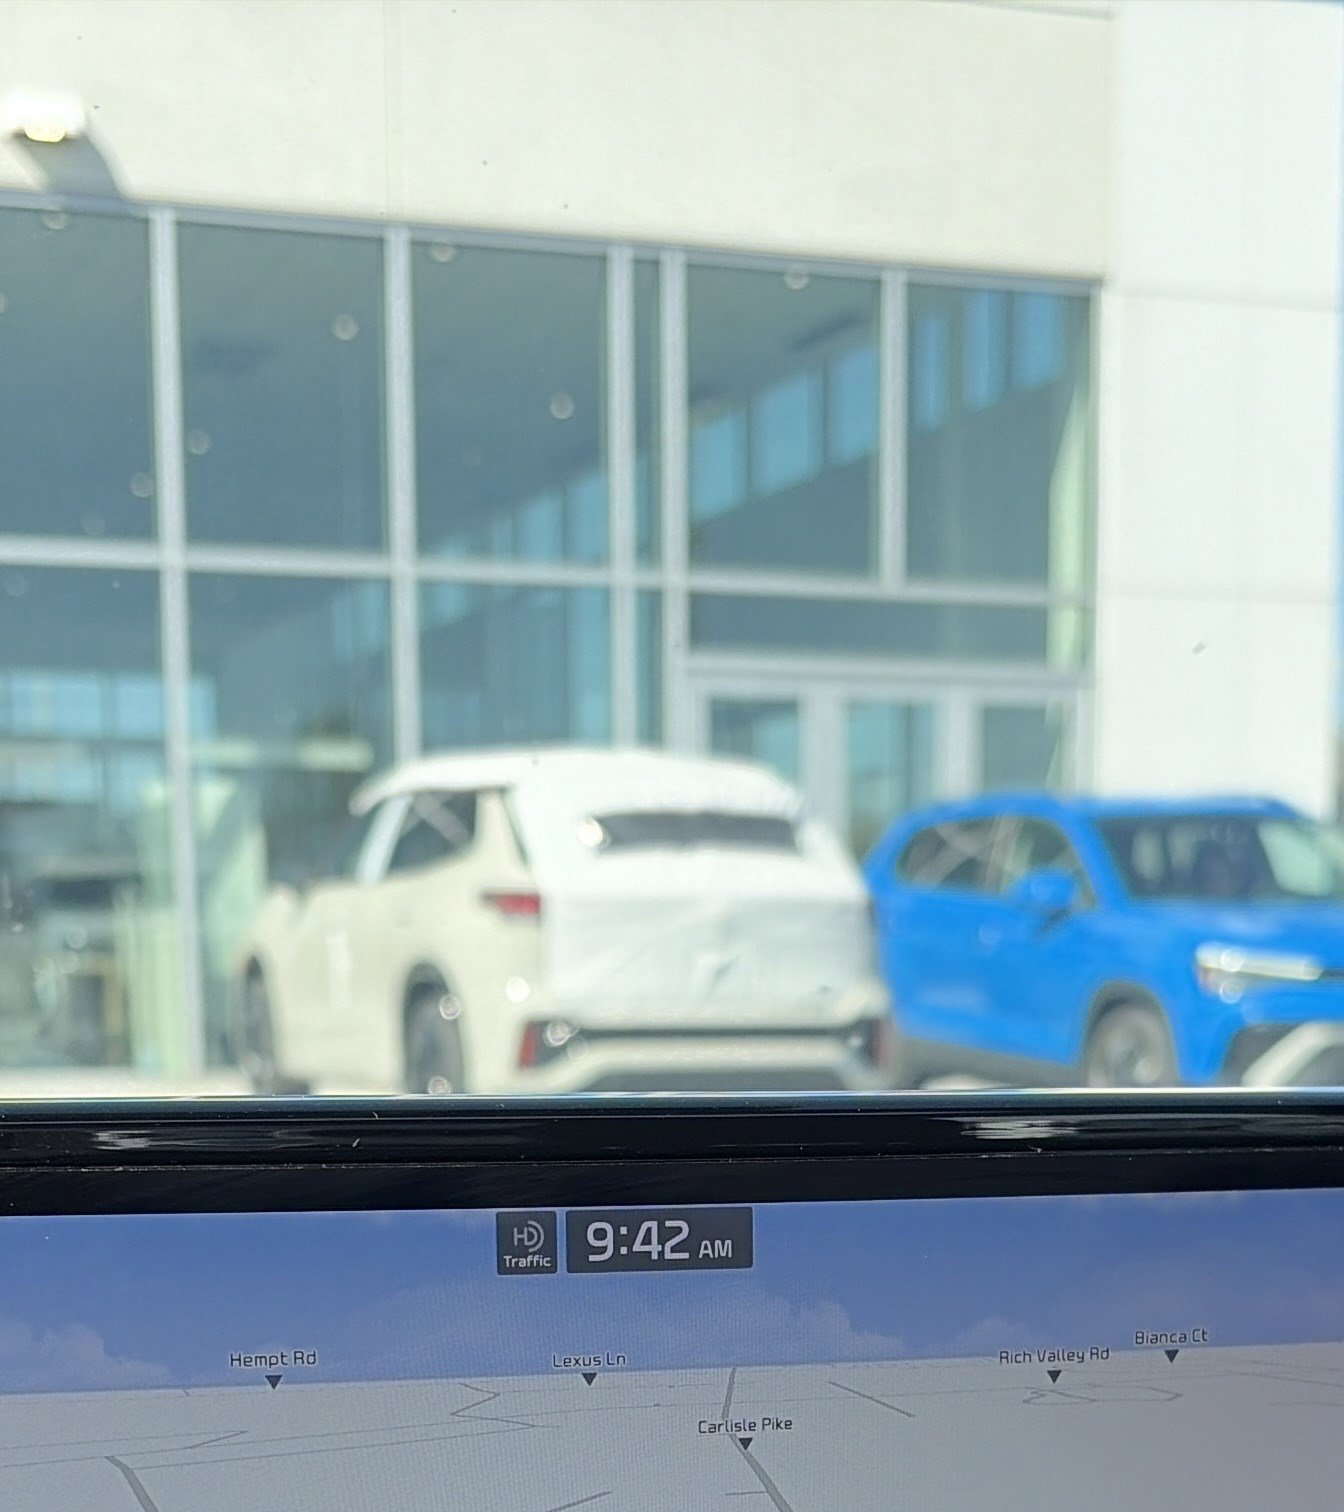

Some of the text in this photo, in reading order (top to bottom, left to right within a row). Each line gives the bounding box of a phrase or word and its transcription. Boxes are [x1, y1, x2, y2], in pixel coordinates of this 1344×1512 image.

[586, 1219, 733, 1262] 9:42 AM
[503, 1254, 552, 1269] Traffic
[1134, 1327, 1209, 1345] Bianca Ct
[229, 1349, 317, 1369] Hempt Rd
[552, 1350, 627, 1369] Lexus Ln
[998, 1345, 1110, 1365] Rich Valley Rd
[697, 1415, 794, 1435] Carlisle Pike
